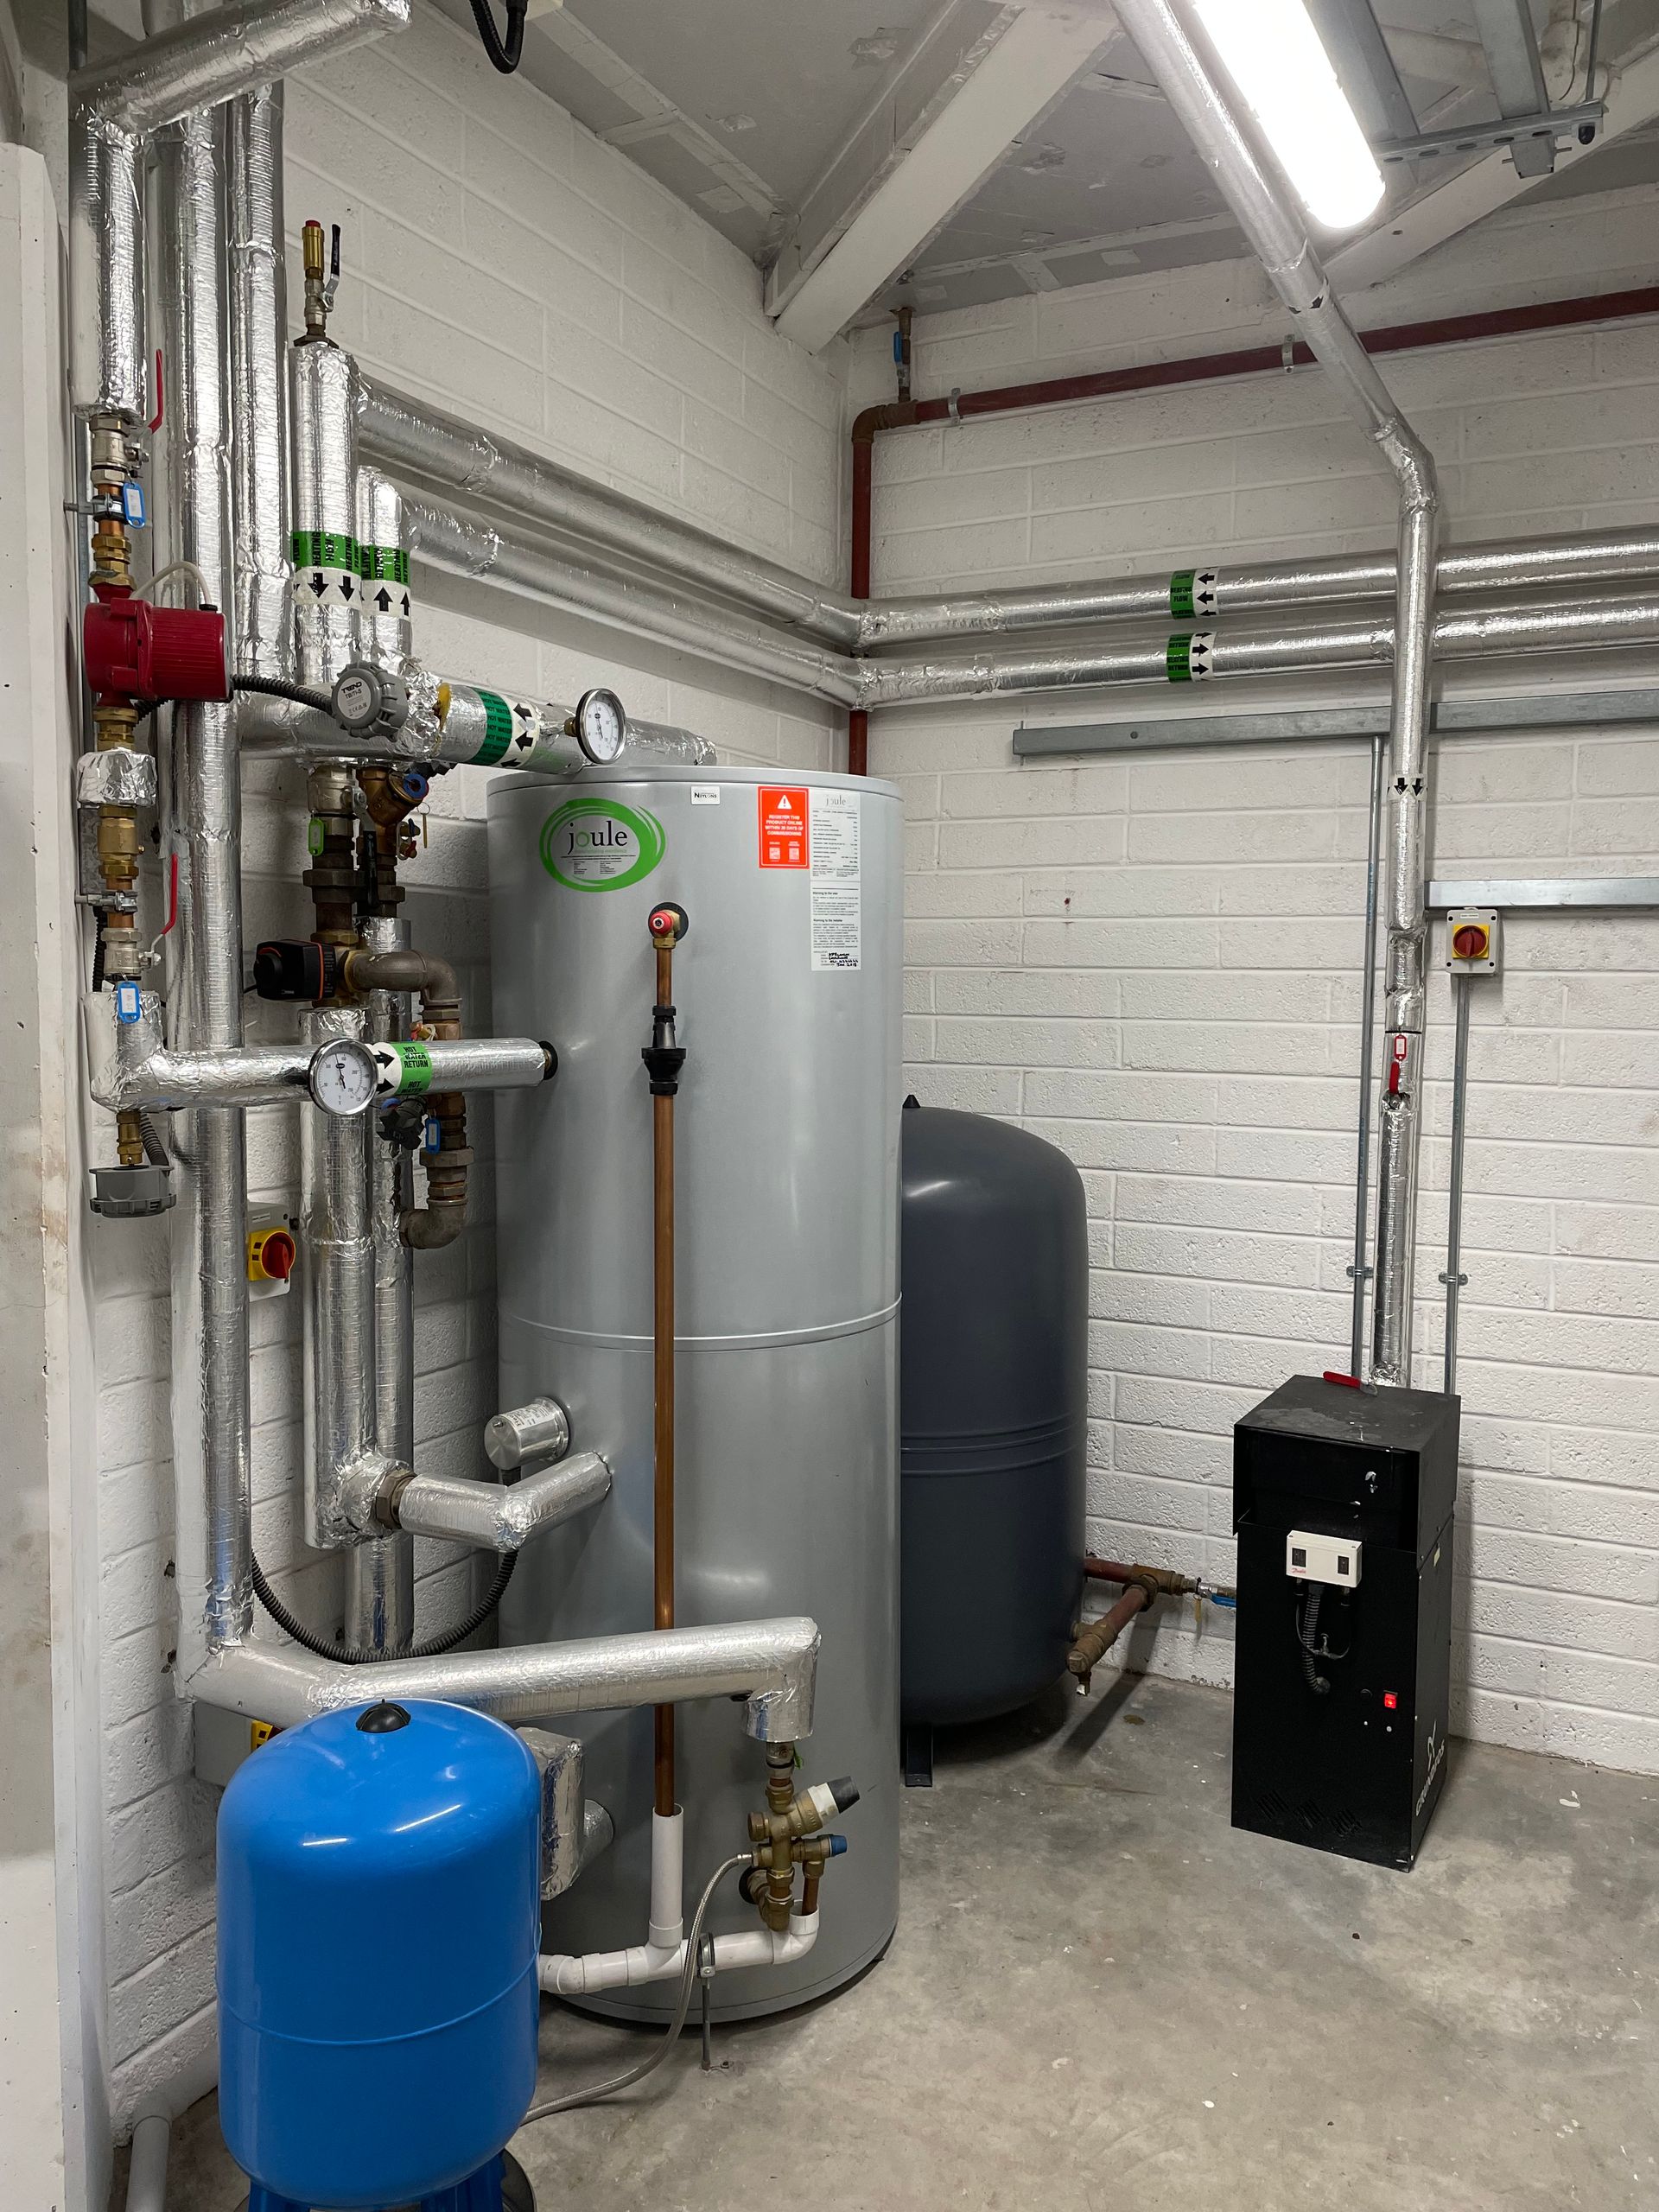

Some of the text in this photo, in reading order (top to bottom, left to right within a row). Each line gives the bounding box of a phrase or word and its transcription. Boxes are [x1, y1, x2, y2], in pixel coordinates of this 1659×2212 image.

[312, 531, 321, 566] HEATING
[341, 682, 362, 694] TREND
[568, 820, 628, 855] joule
[1416, 1738, 1445, 1816] GRUNDFOS
